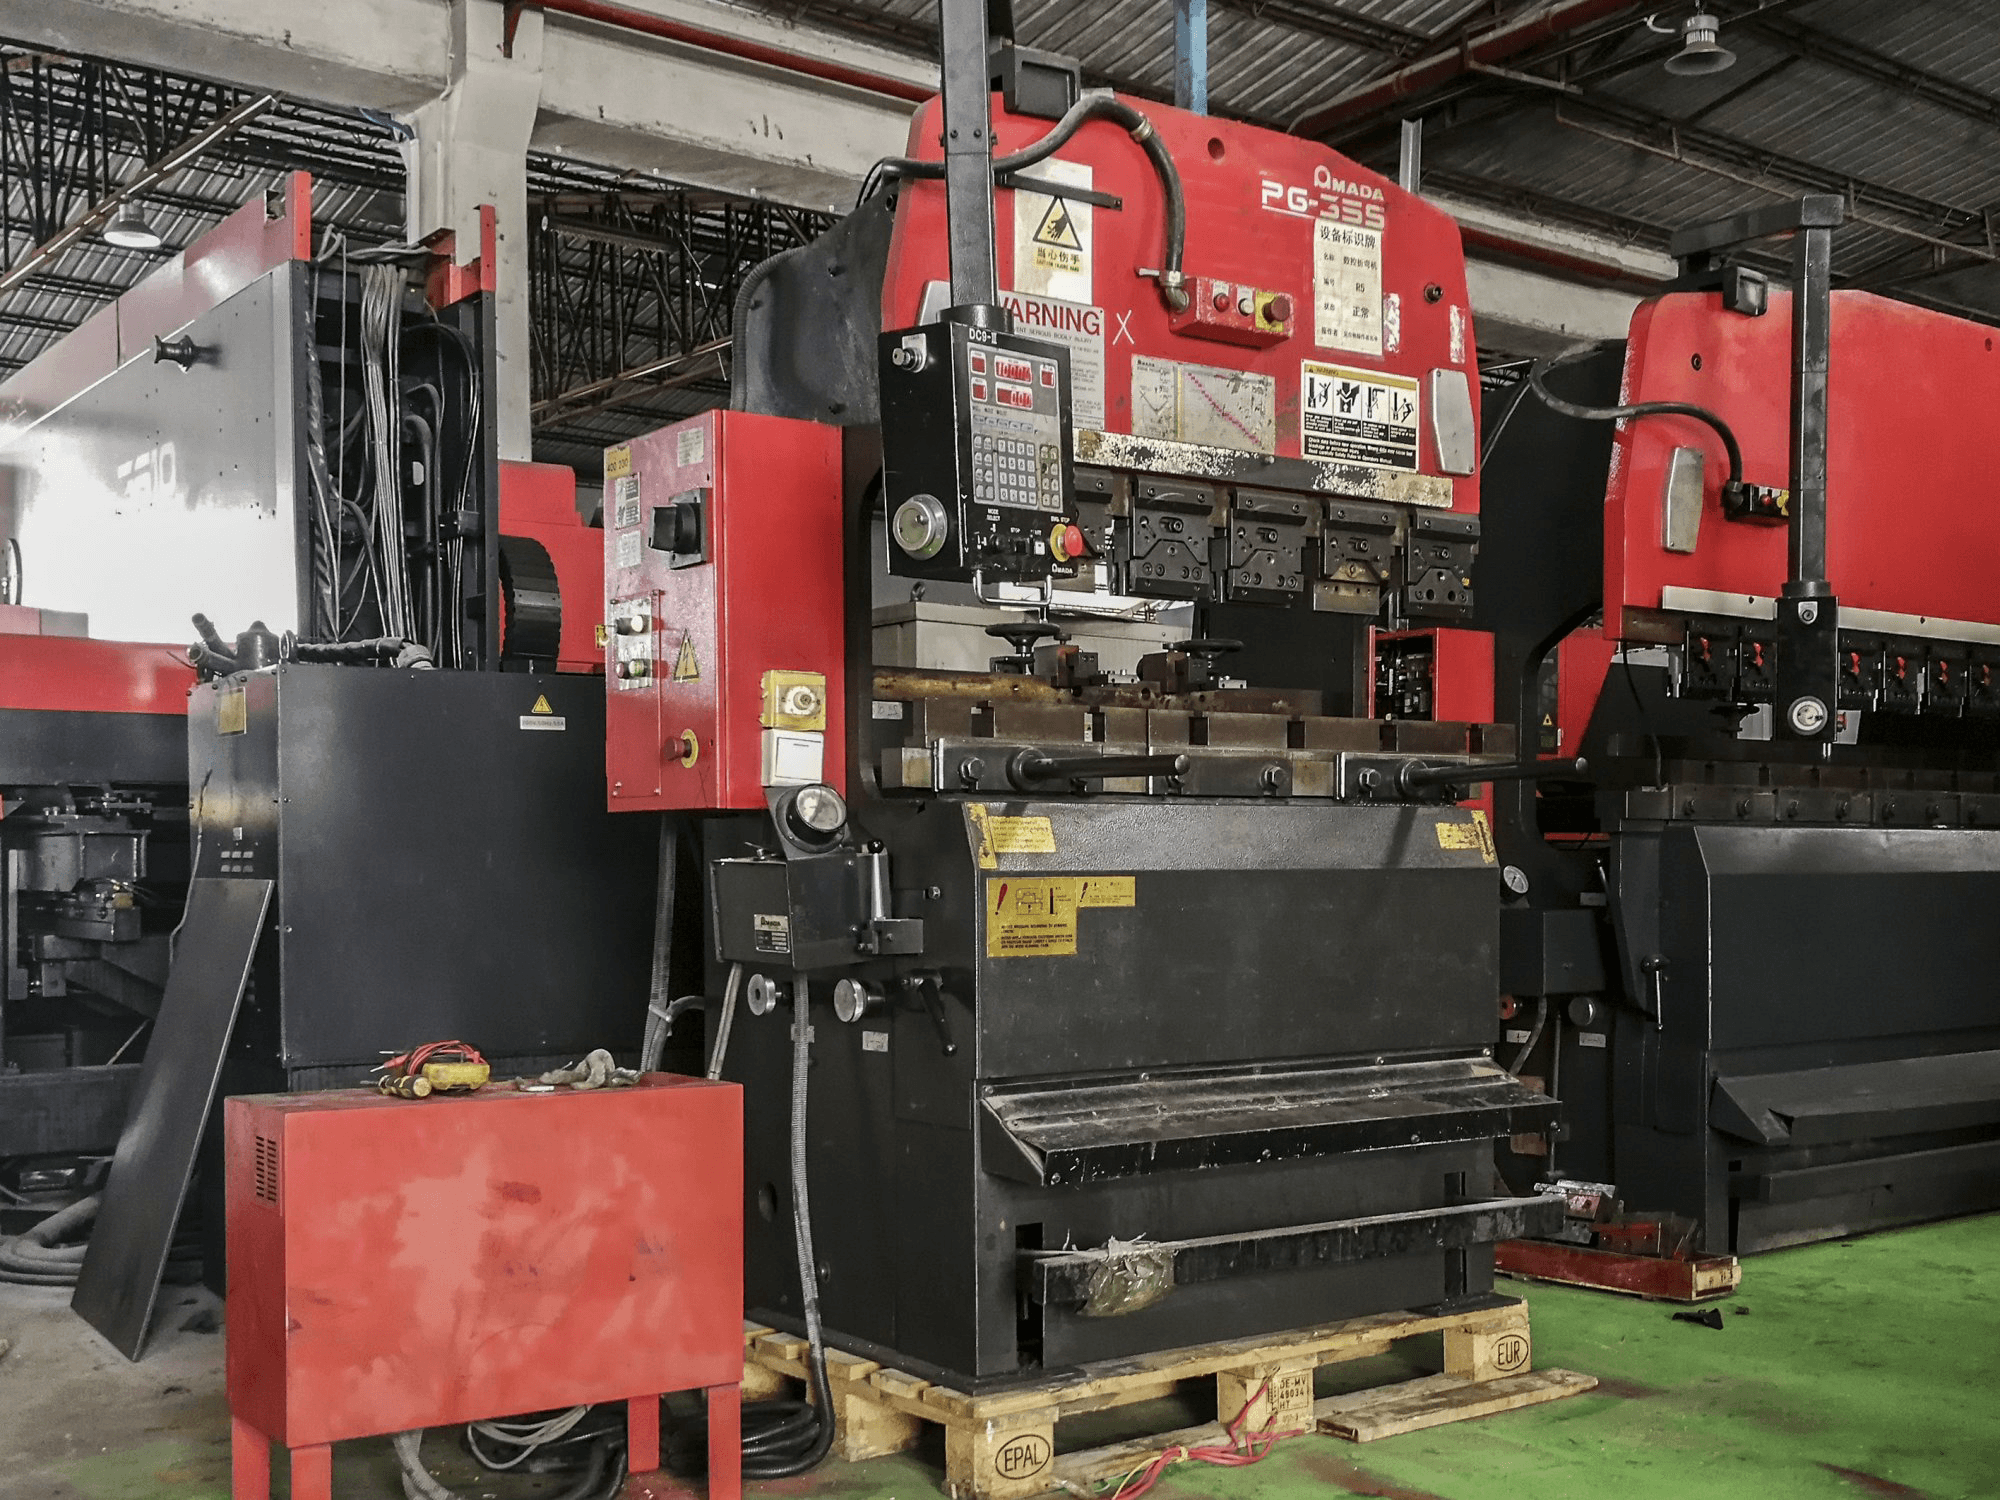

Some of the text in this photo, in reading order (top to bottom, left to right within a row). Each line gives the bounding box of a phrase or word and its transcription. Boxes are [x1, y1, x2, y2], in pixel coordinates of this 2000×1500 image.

[1261, 179, 1385, 231] PG-35S
[1320, 225, 1376, 250] 设备标识牌
[1037, 247, 1080, 264] 当心伤手
[1352, 306, 1369, 319] 正常
[1498, 1340, 1520, 1366] EUR
[1004, 1442, 1043, 1472] EPAL
